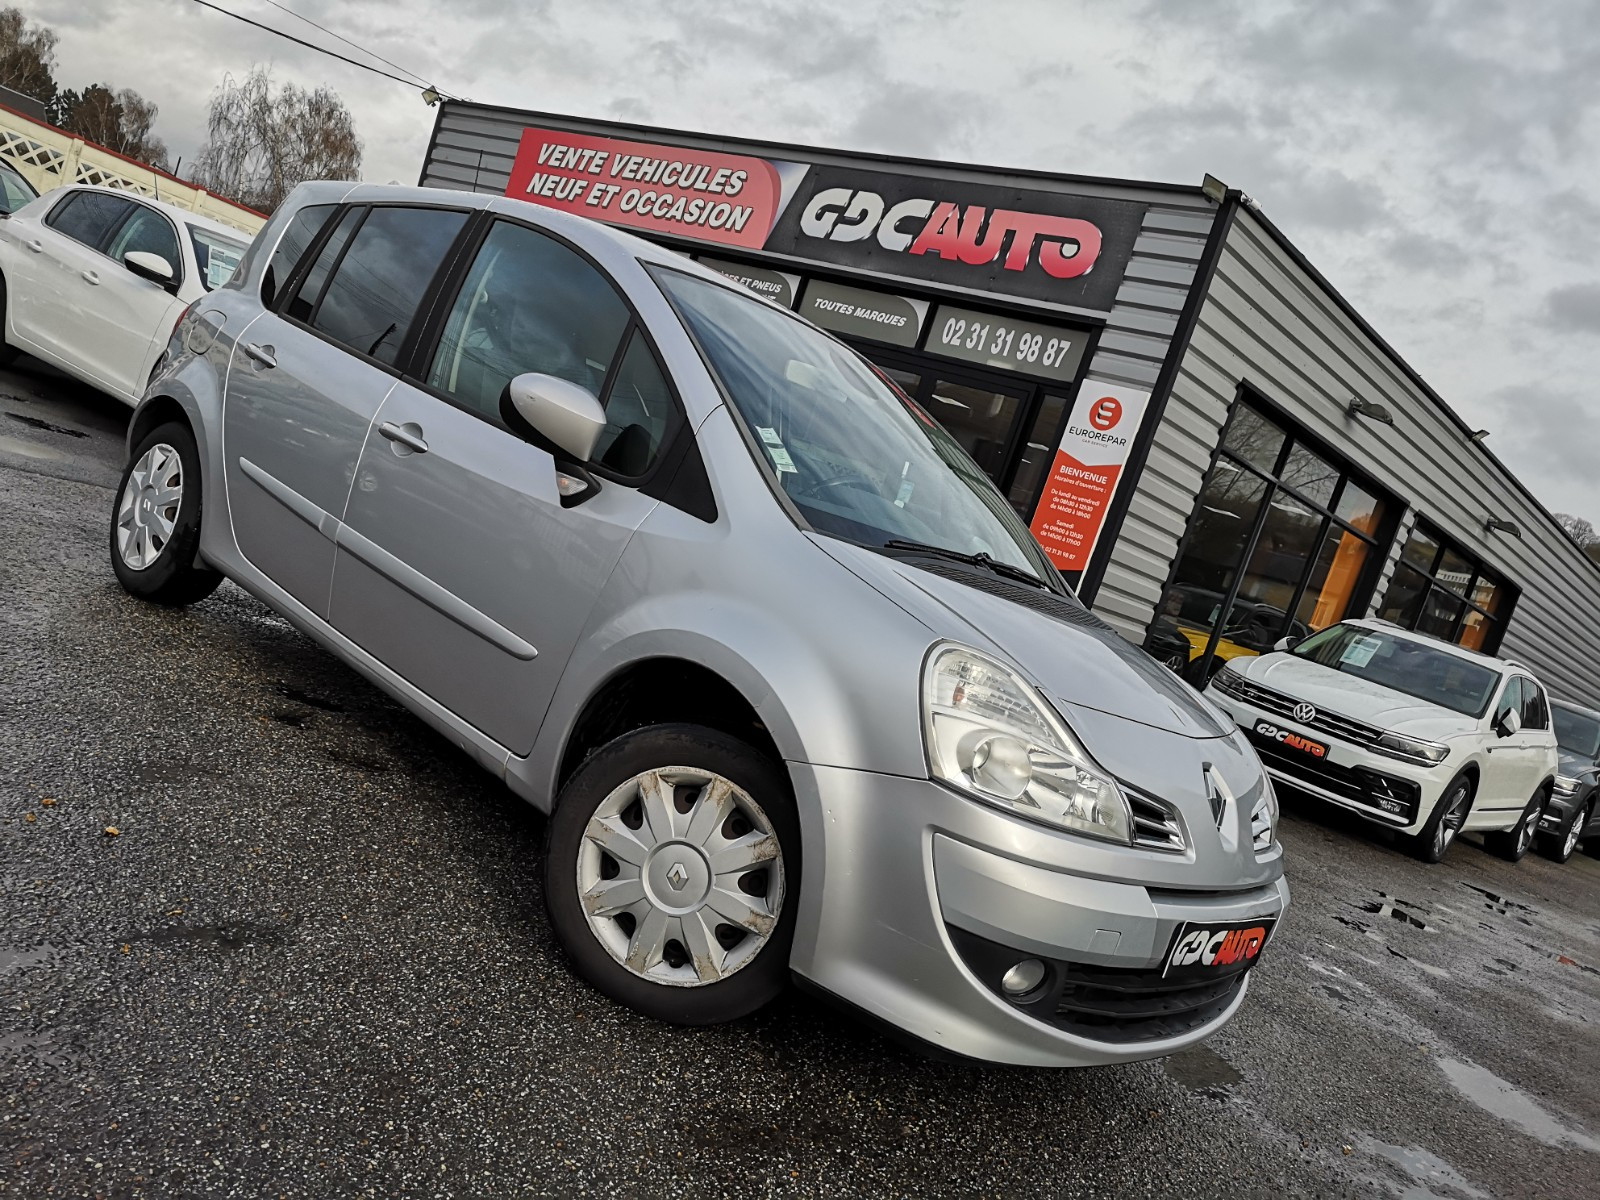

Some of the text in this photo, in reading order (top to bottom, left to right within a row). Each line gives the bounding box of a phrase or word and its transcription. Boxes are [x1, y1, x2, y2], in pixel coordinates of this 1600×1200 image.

[537, 143, 748, 195] VENTE VEHICULES
[526, 172, 752, 232] NEUF ET OCCASION
[751, 280, 782, 293] PNEUS
[814, 298, 907, 327] TOUTES MARQUES
[942, 317, 1072, 368] 02 31 31 98 87
[1069, 426, 1127, 446] EUROREPAR
[1054, 475, 1075, 485] Horaires
[1060, 465, 1107, 484] BIENVENUE
[1058, 490, 1071, 498] lundi
[1078, 497, 1100, 506] vendredi
[1056, 520, 1074, 529] Samedi
